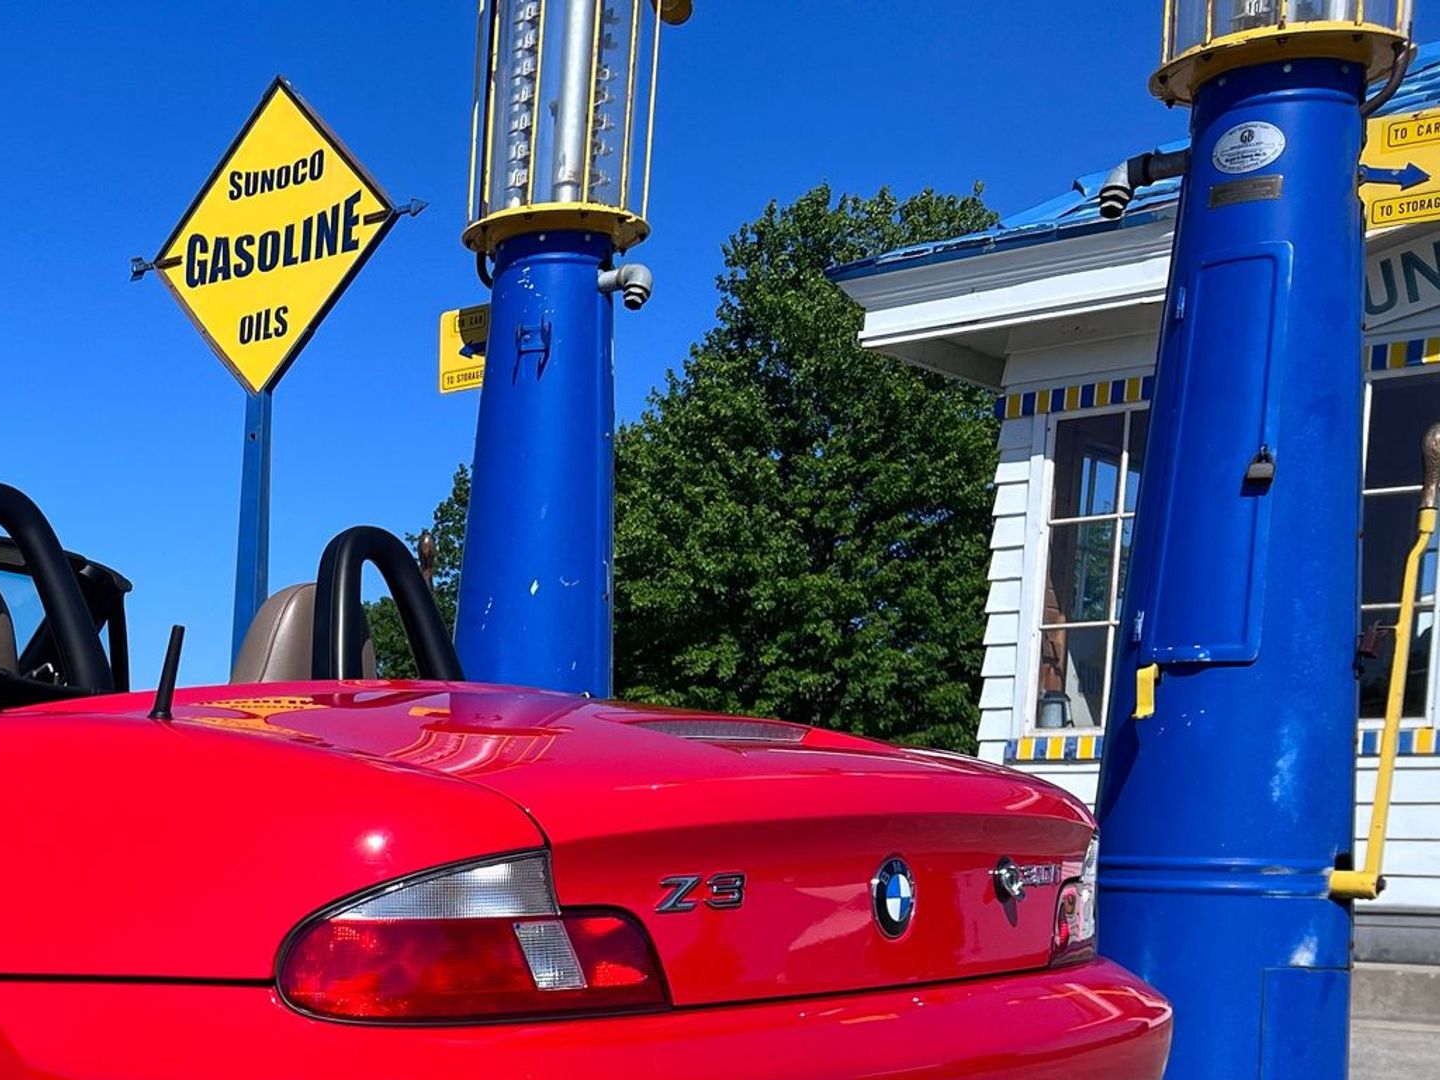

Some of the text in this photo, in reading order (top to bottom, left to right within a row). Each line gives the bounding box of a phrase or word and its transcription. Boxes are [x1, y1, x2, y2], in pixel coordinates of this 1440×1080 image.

[1393, 120, 1440, 141] TO CAR
[229, 149, 325, 201] SUNOCO
[1380, 203, 1393, 218] TO
[185, 189, 362, 289] GASOLINE
[239, 305, 289, 345] OILS
[655, 871, 747, 914] Z3
